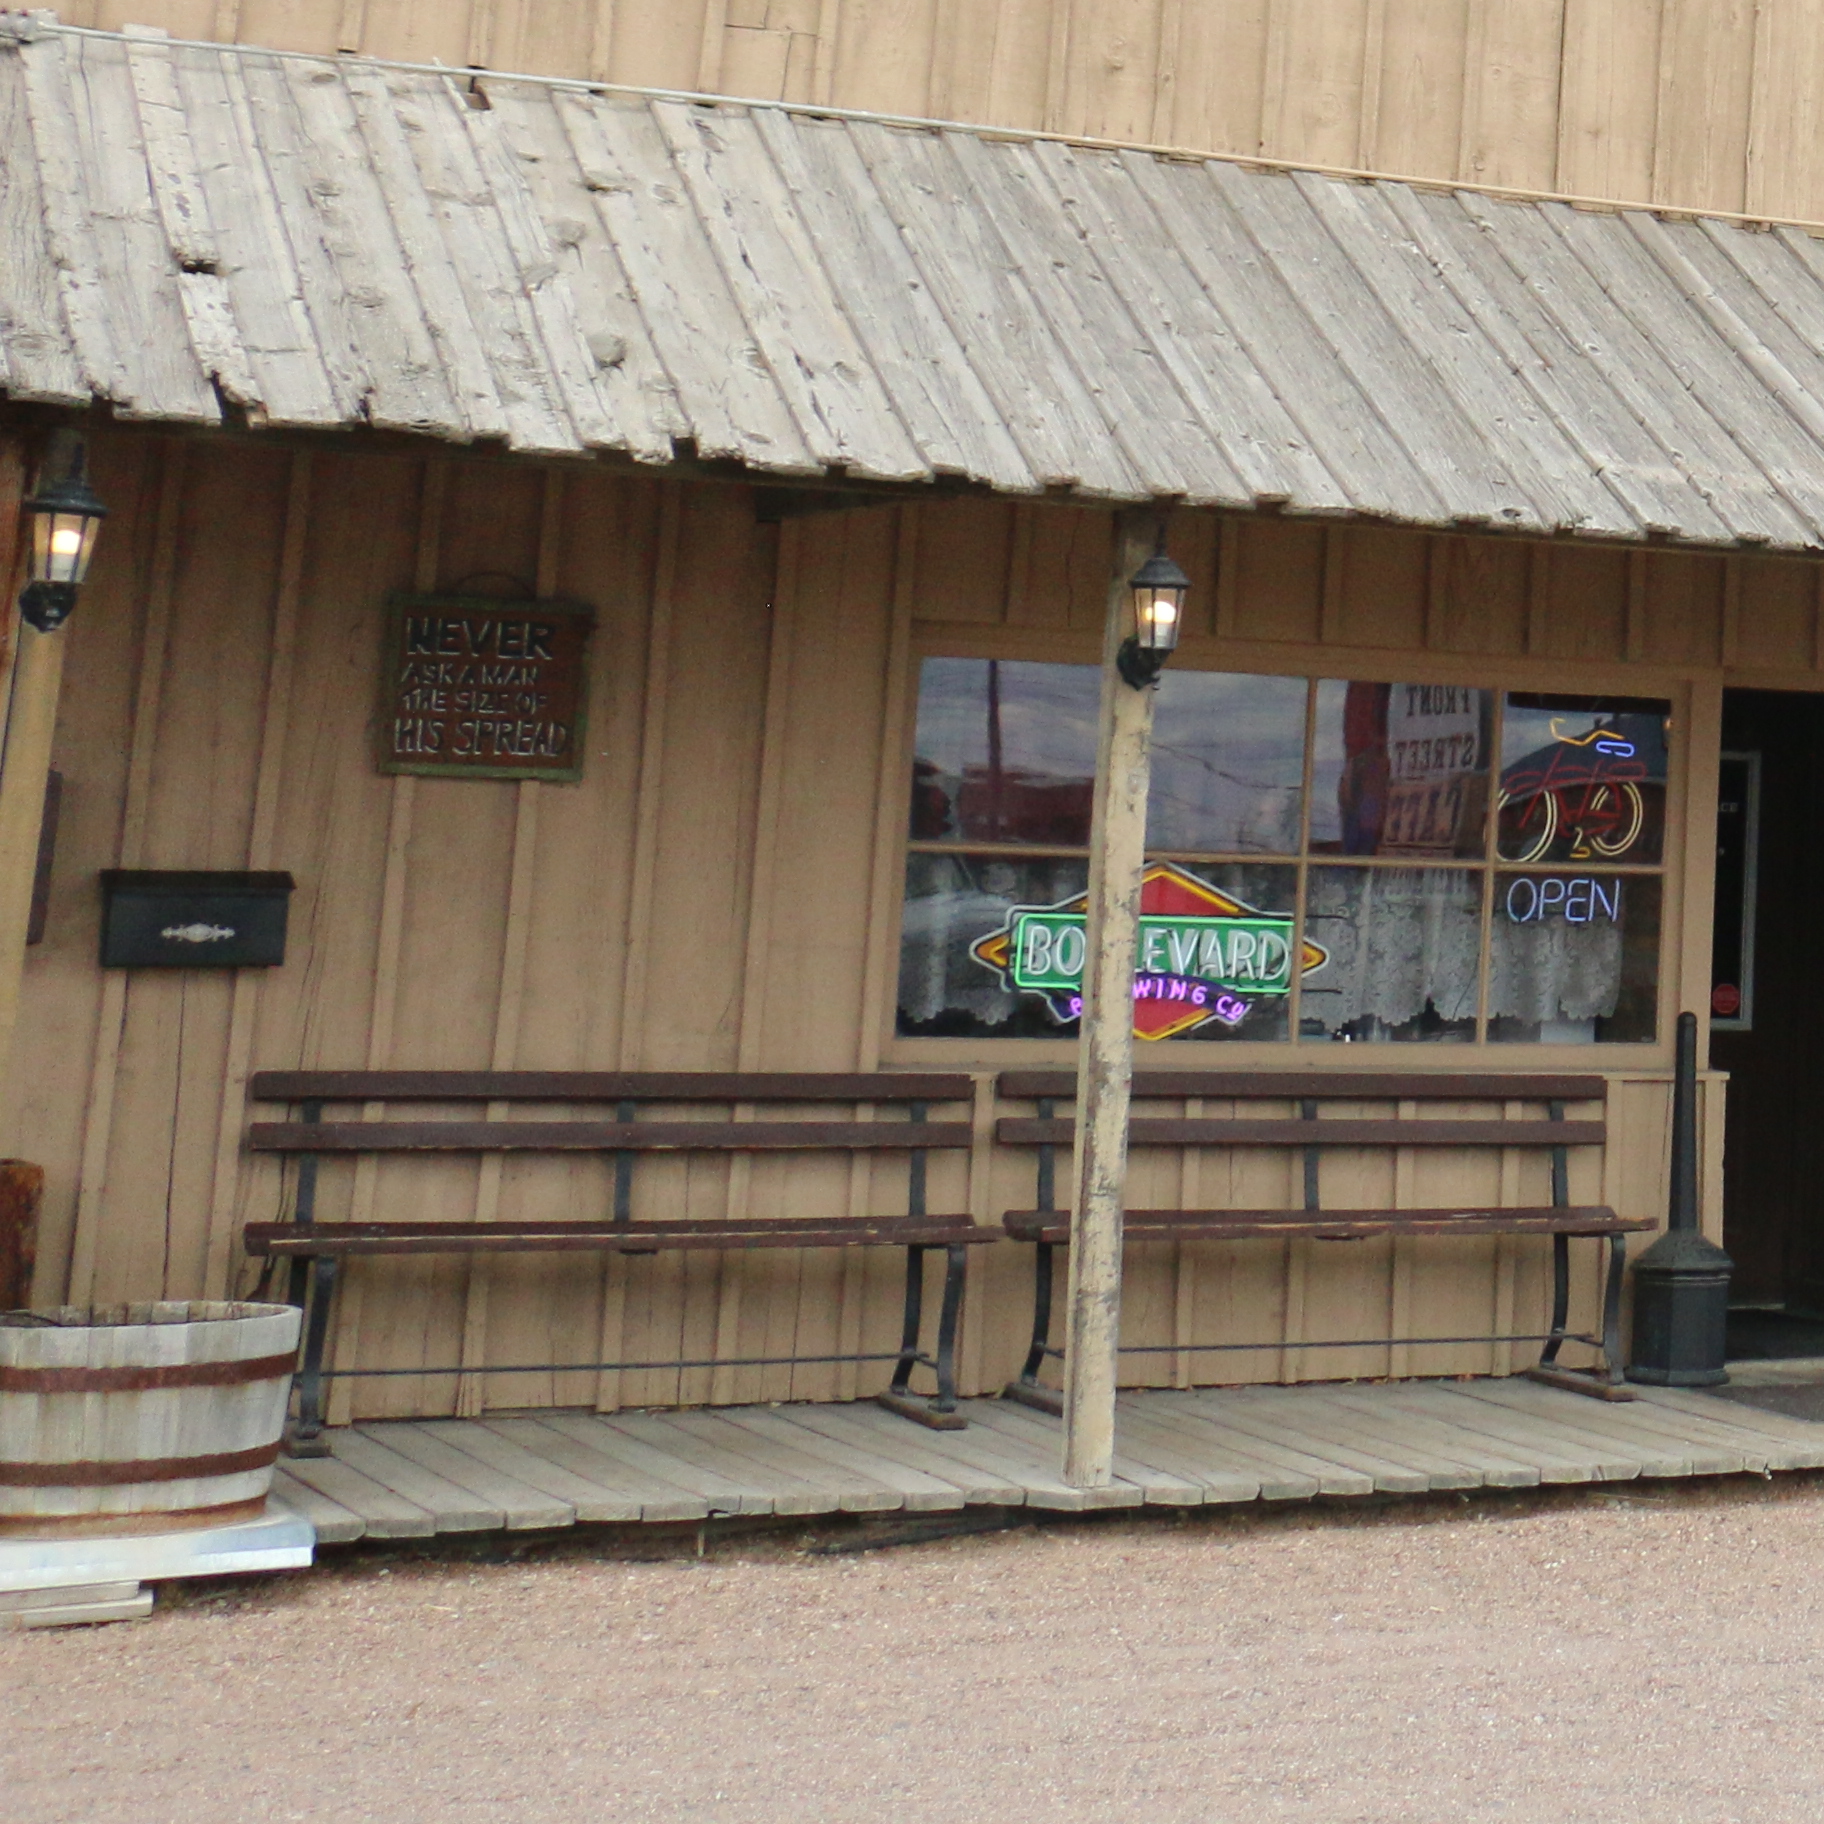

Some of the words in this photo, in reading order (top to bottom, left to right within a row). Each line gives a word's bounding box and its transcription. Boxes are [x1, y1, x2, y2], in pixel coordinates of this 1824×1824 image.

[406, 616, 553, 661] NEVER
[401, 662, 453, 685] ASK
[481, 664, 538, 686] MAN
[402, 688, 447, 713] THE
[454, 690, 509, 714] SIZE
[395, 717, 445, 754] HIS
[451, 718, 569, 758] SPREAD
[1506, 878, 1622, 924] OPEN
[1025, 923, 1292, 982] BOEVARD
[1070, 978, 1208, 1016] BWING
